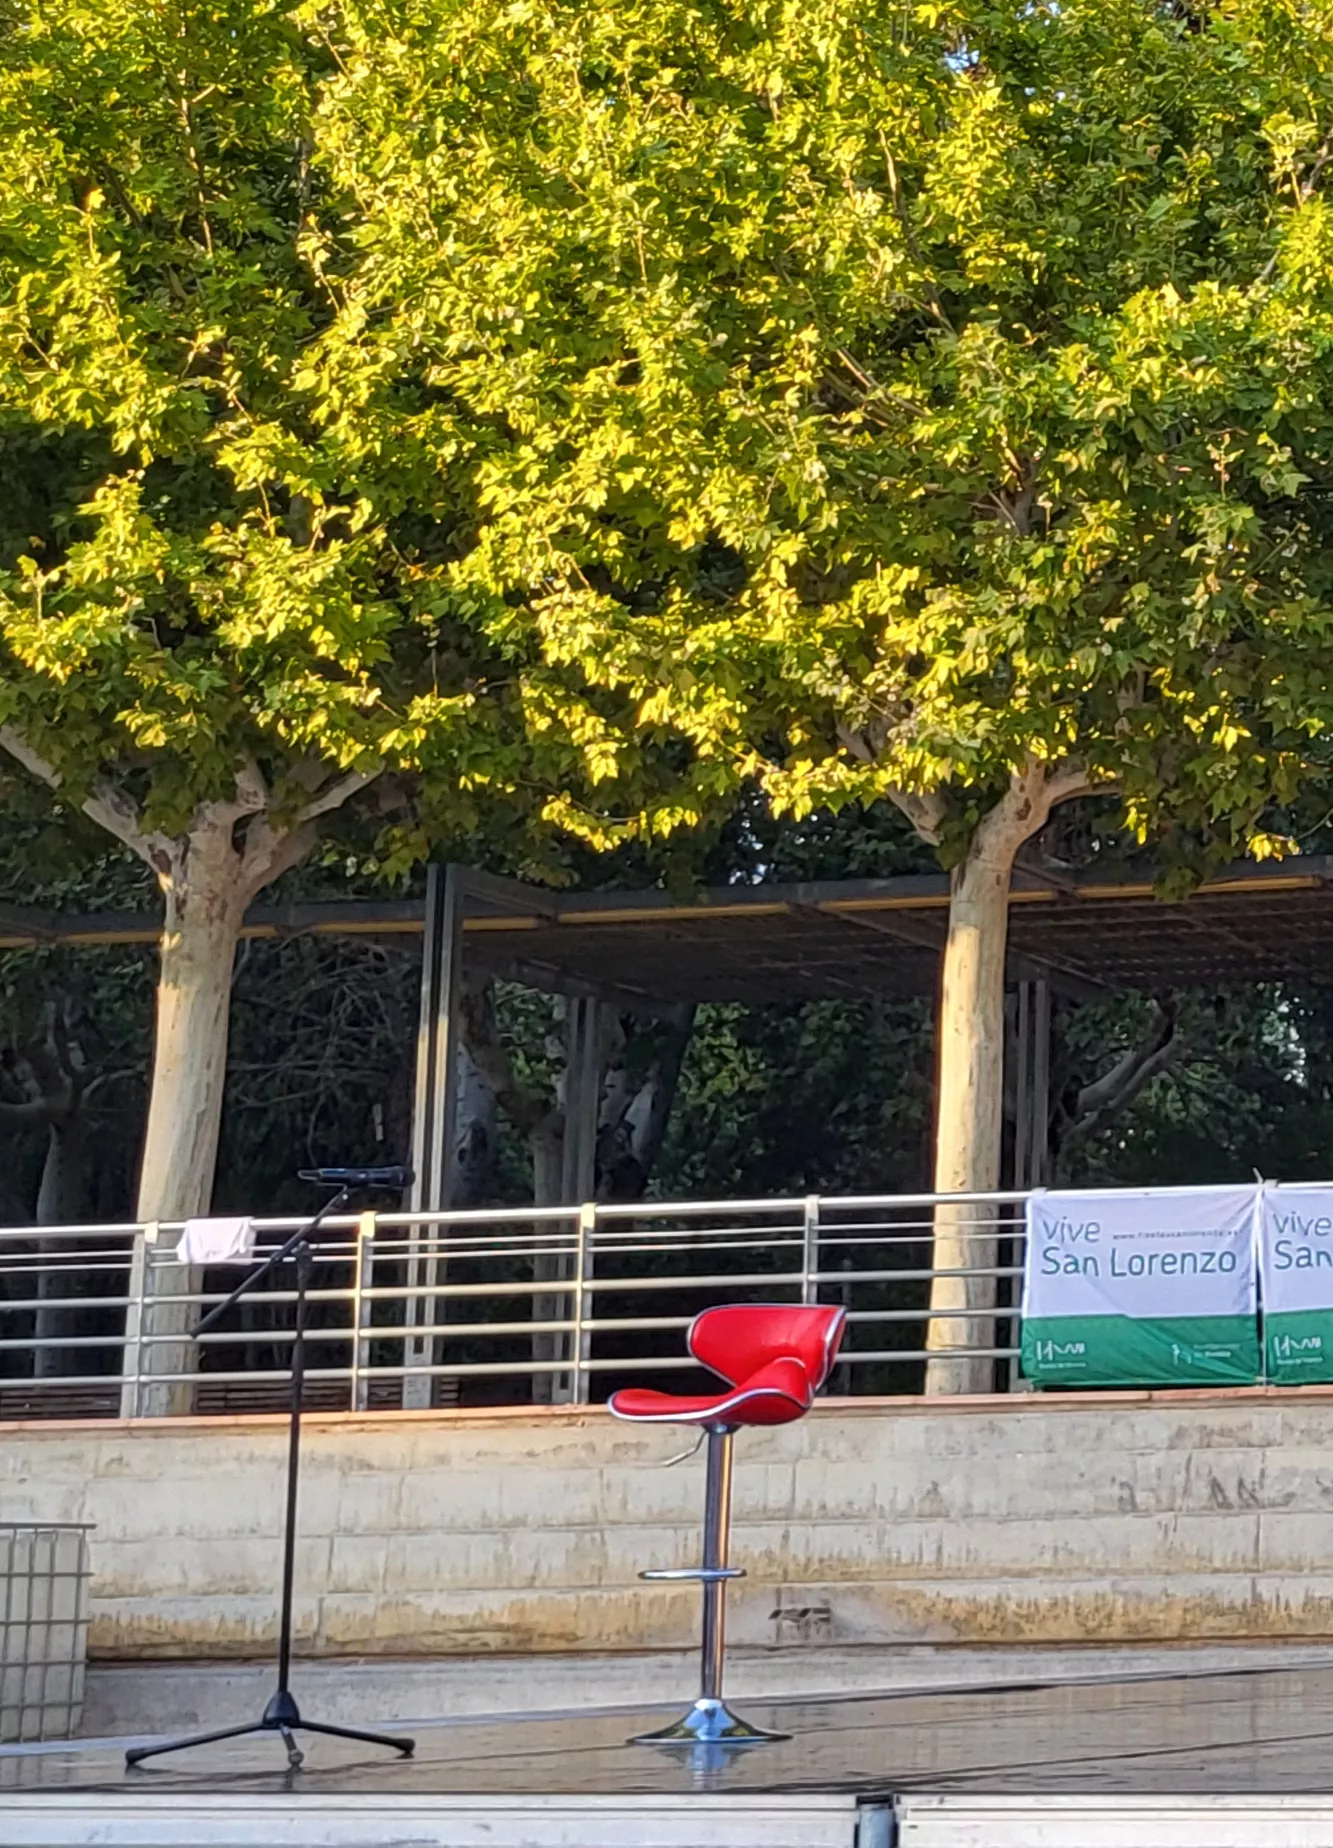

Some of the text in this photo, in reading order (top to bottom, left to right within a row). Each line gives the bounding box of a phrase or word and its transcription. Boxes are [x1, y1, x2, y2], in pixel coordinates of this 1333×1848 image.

[1042, 1216, 1101, 1243] vive
[1272, 1211, 1333, 1237] vive
[1041, 1246, 1237, 1277] San Lorenzo
[1273, 1240, 1333, 1270] San
